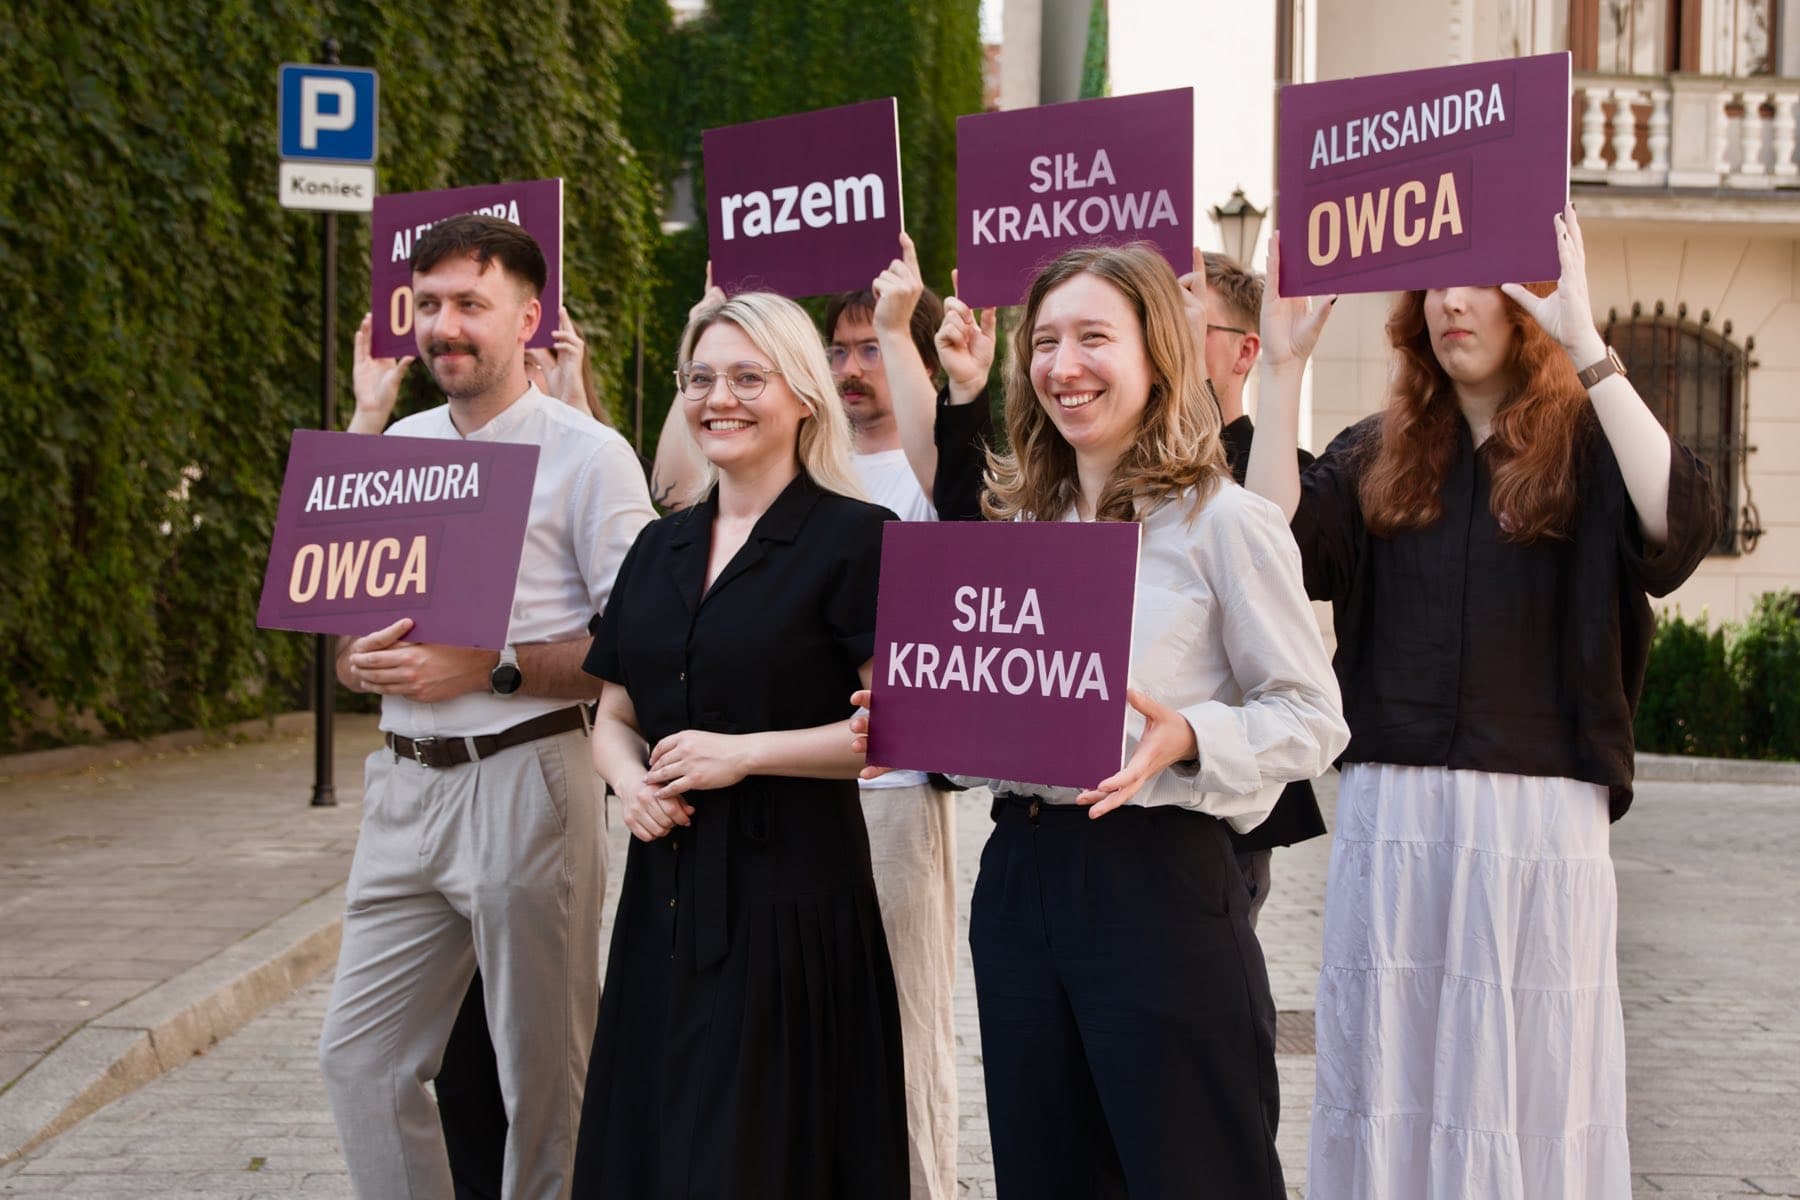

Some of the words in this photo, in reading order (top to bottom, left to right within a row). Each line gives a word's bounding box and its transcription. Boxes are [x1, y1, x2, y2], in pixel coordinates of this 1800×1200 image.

[301, 77, 356, 149] P
[1309, 83, 1506, 170] ALEKSANDRA
[290, 177, 364, 198] Koniec
[1029, 149, 1116, 193] SIŁA
[720, 172, 886, 241] razem
[972, 189, 1179, 245] KRAKOWA
[1307, 172, 1464, 267] OWCA
[304, 462, 480, 513] ALEKSANDRA
[288, 535, 428, 603] OWCA
[952, 585, 1045, 635] SIŁA
[887, 642, 1110, 701] KRAKOWA
